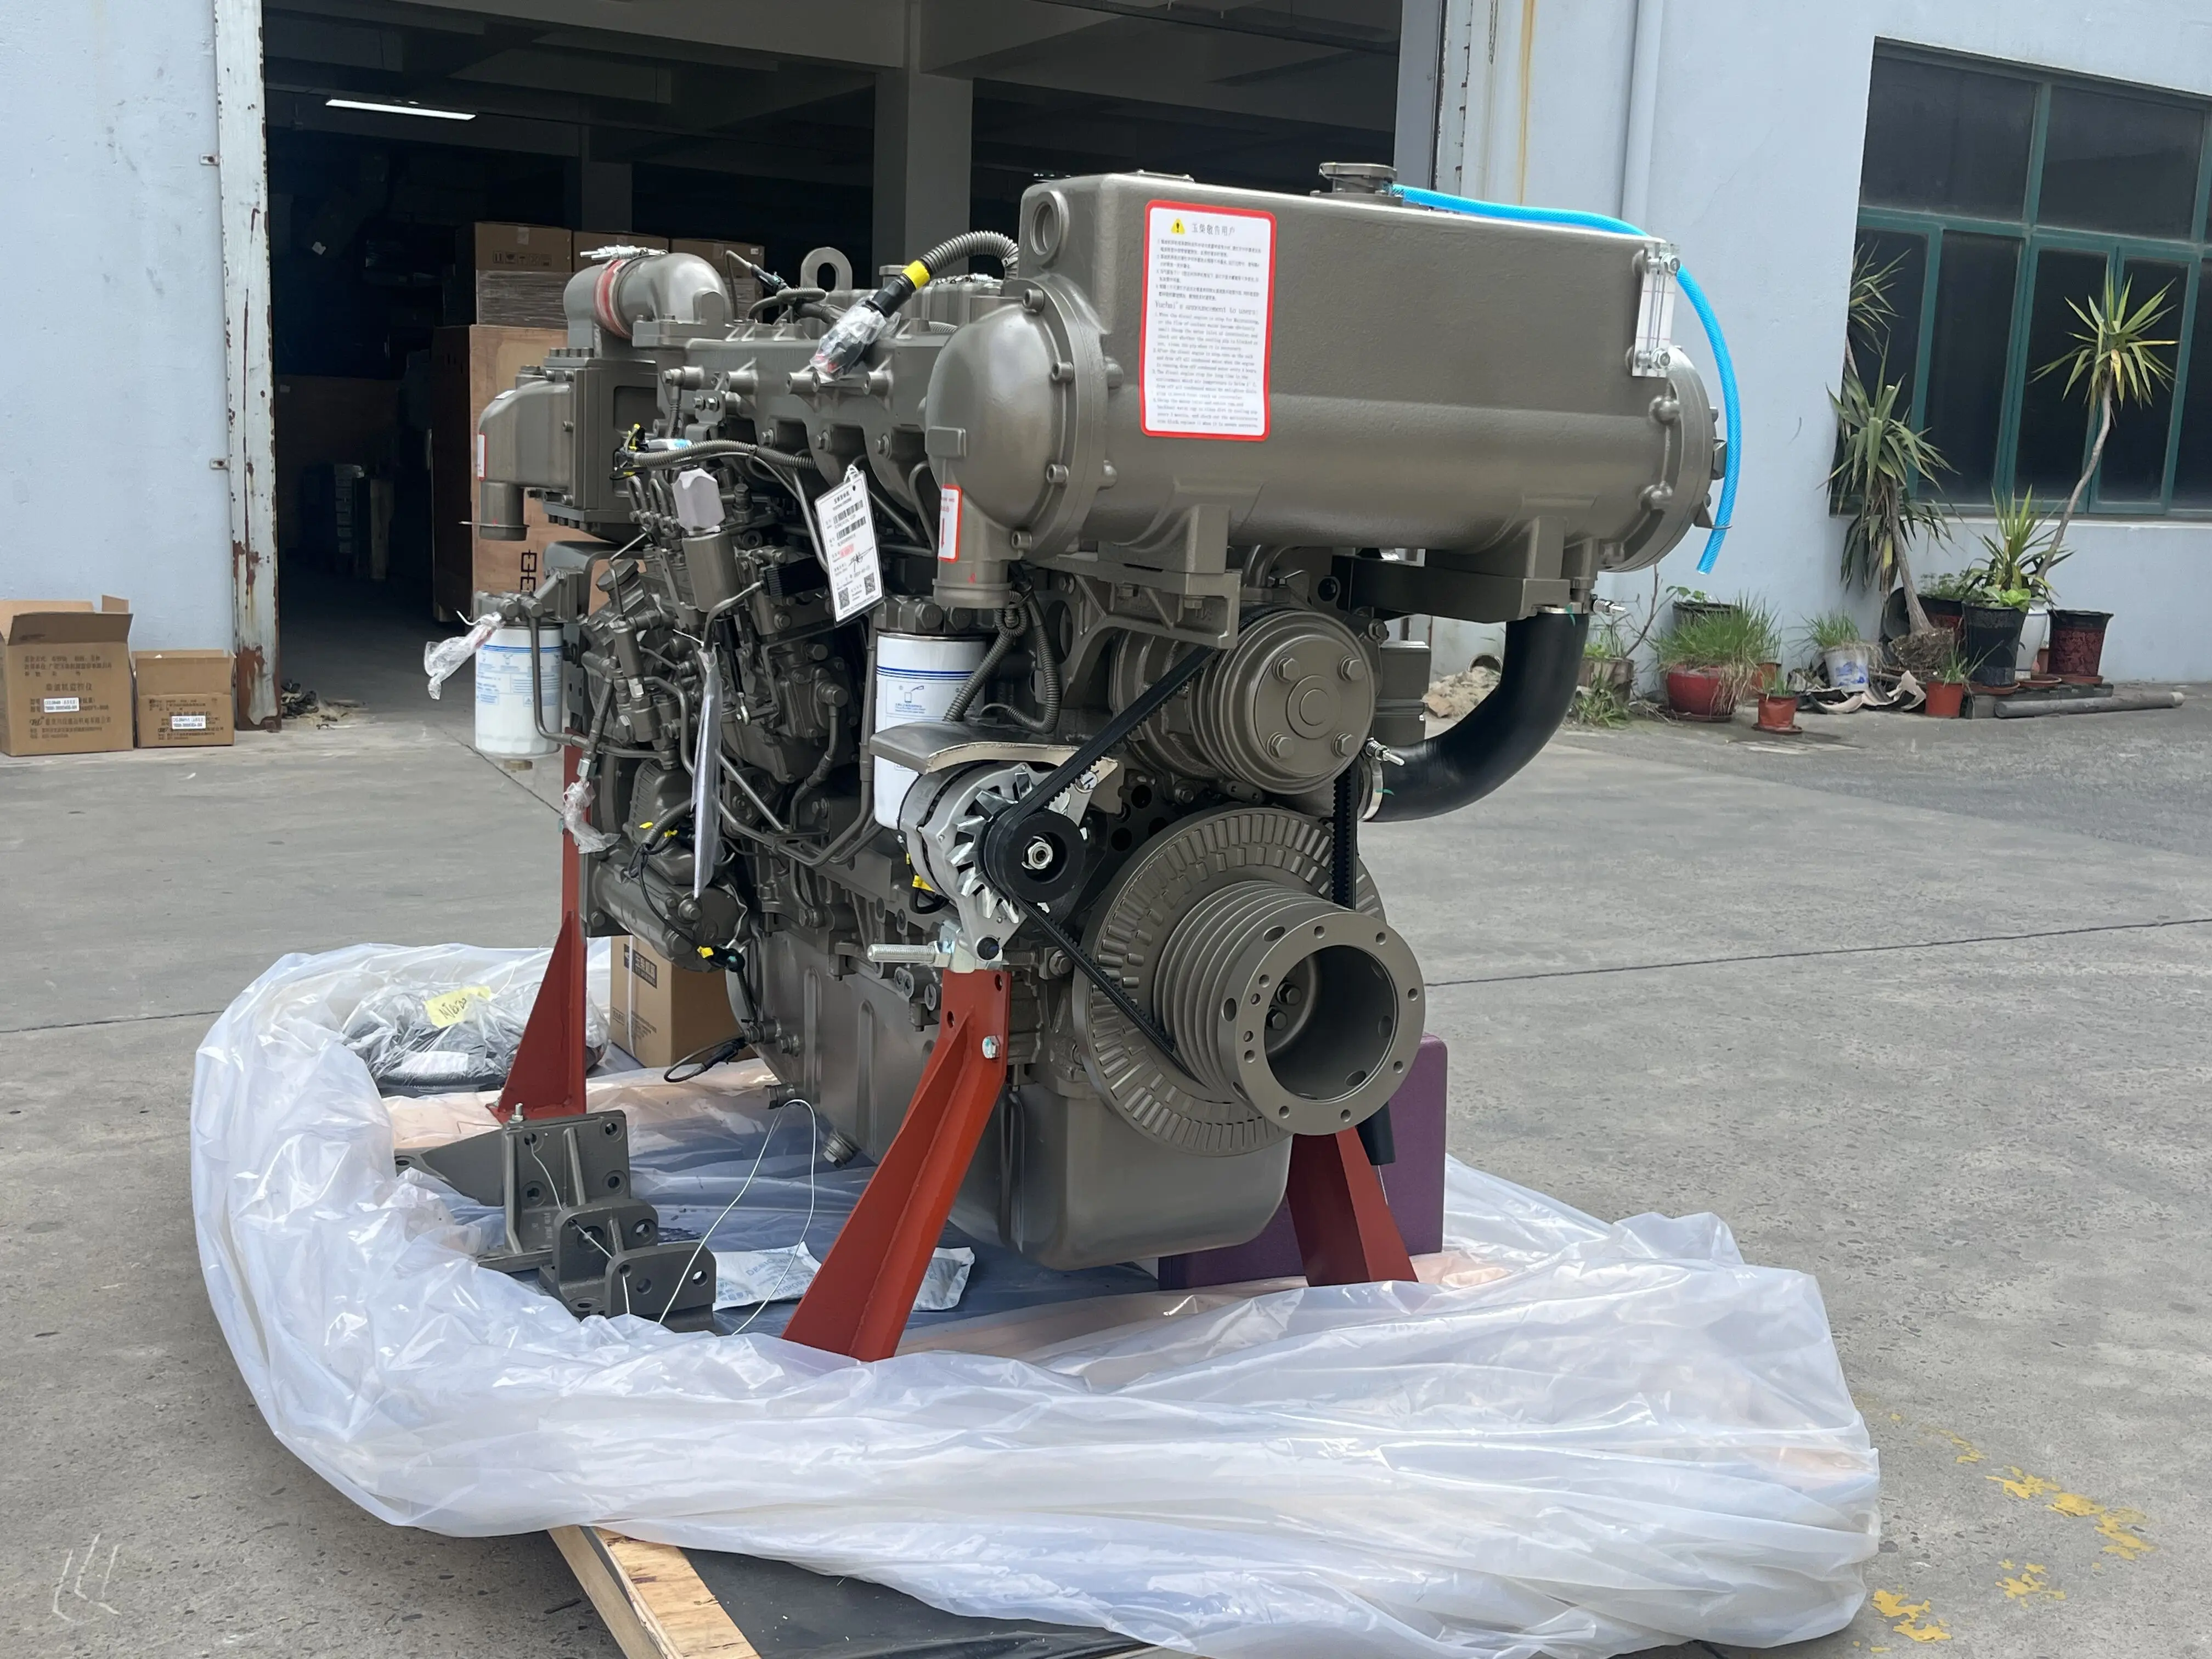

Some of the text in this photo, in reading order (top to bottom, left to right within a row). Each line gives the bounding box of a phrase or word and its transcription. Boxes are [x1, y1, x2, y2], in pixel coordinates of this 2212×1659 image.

[1192, 223, 1235, 236] 玉柴敬告用户
